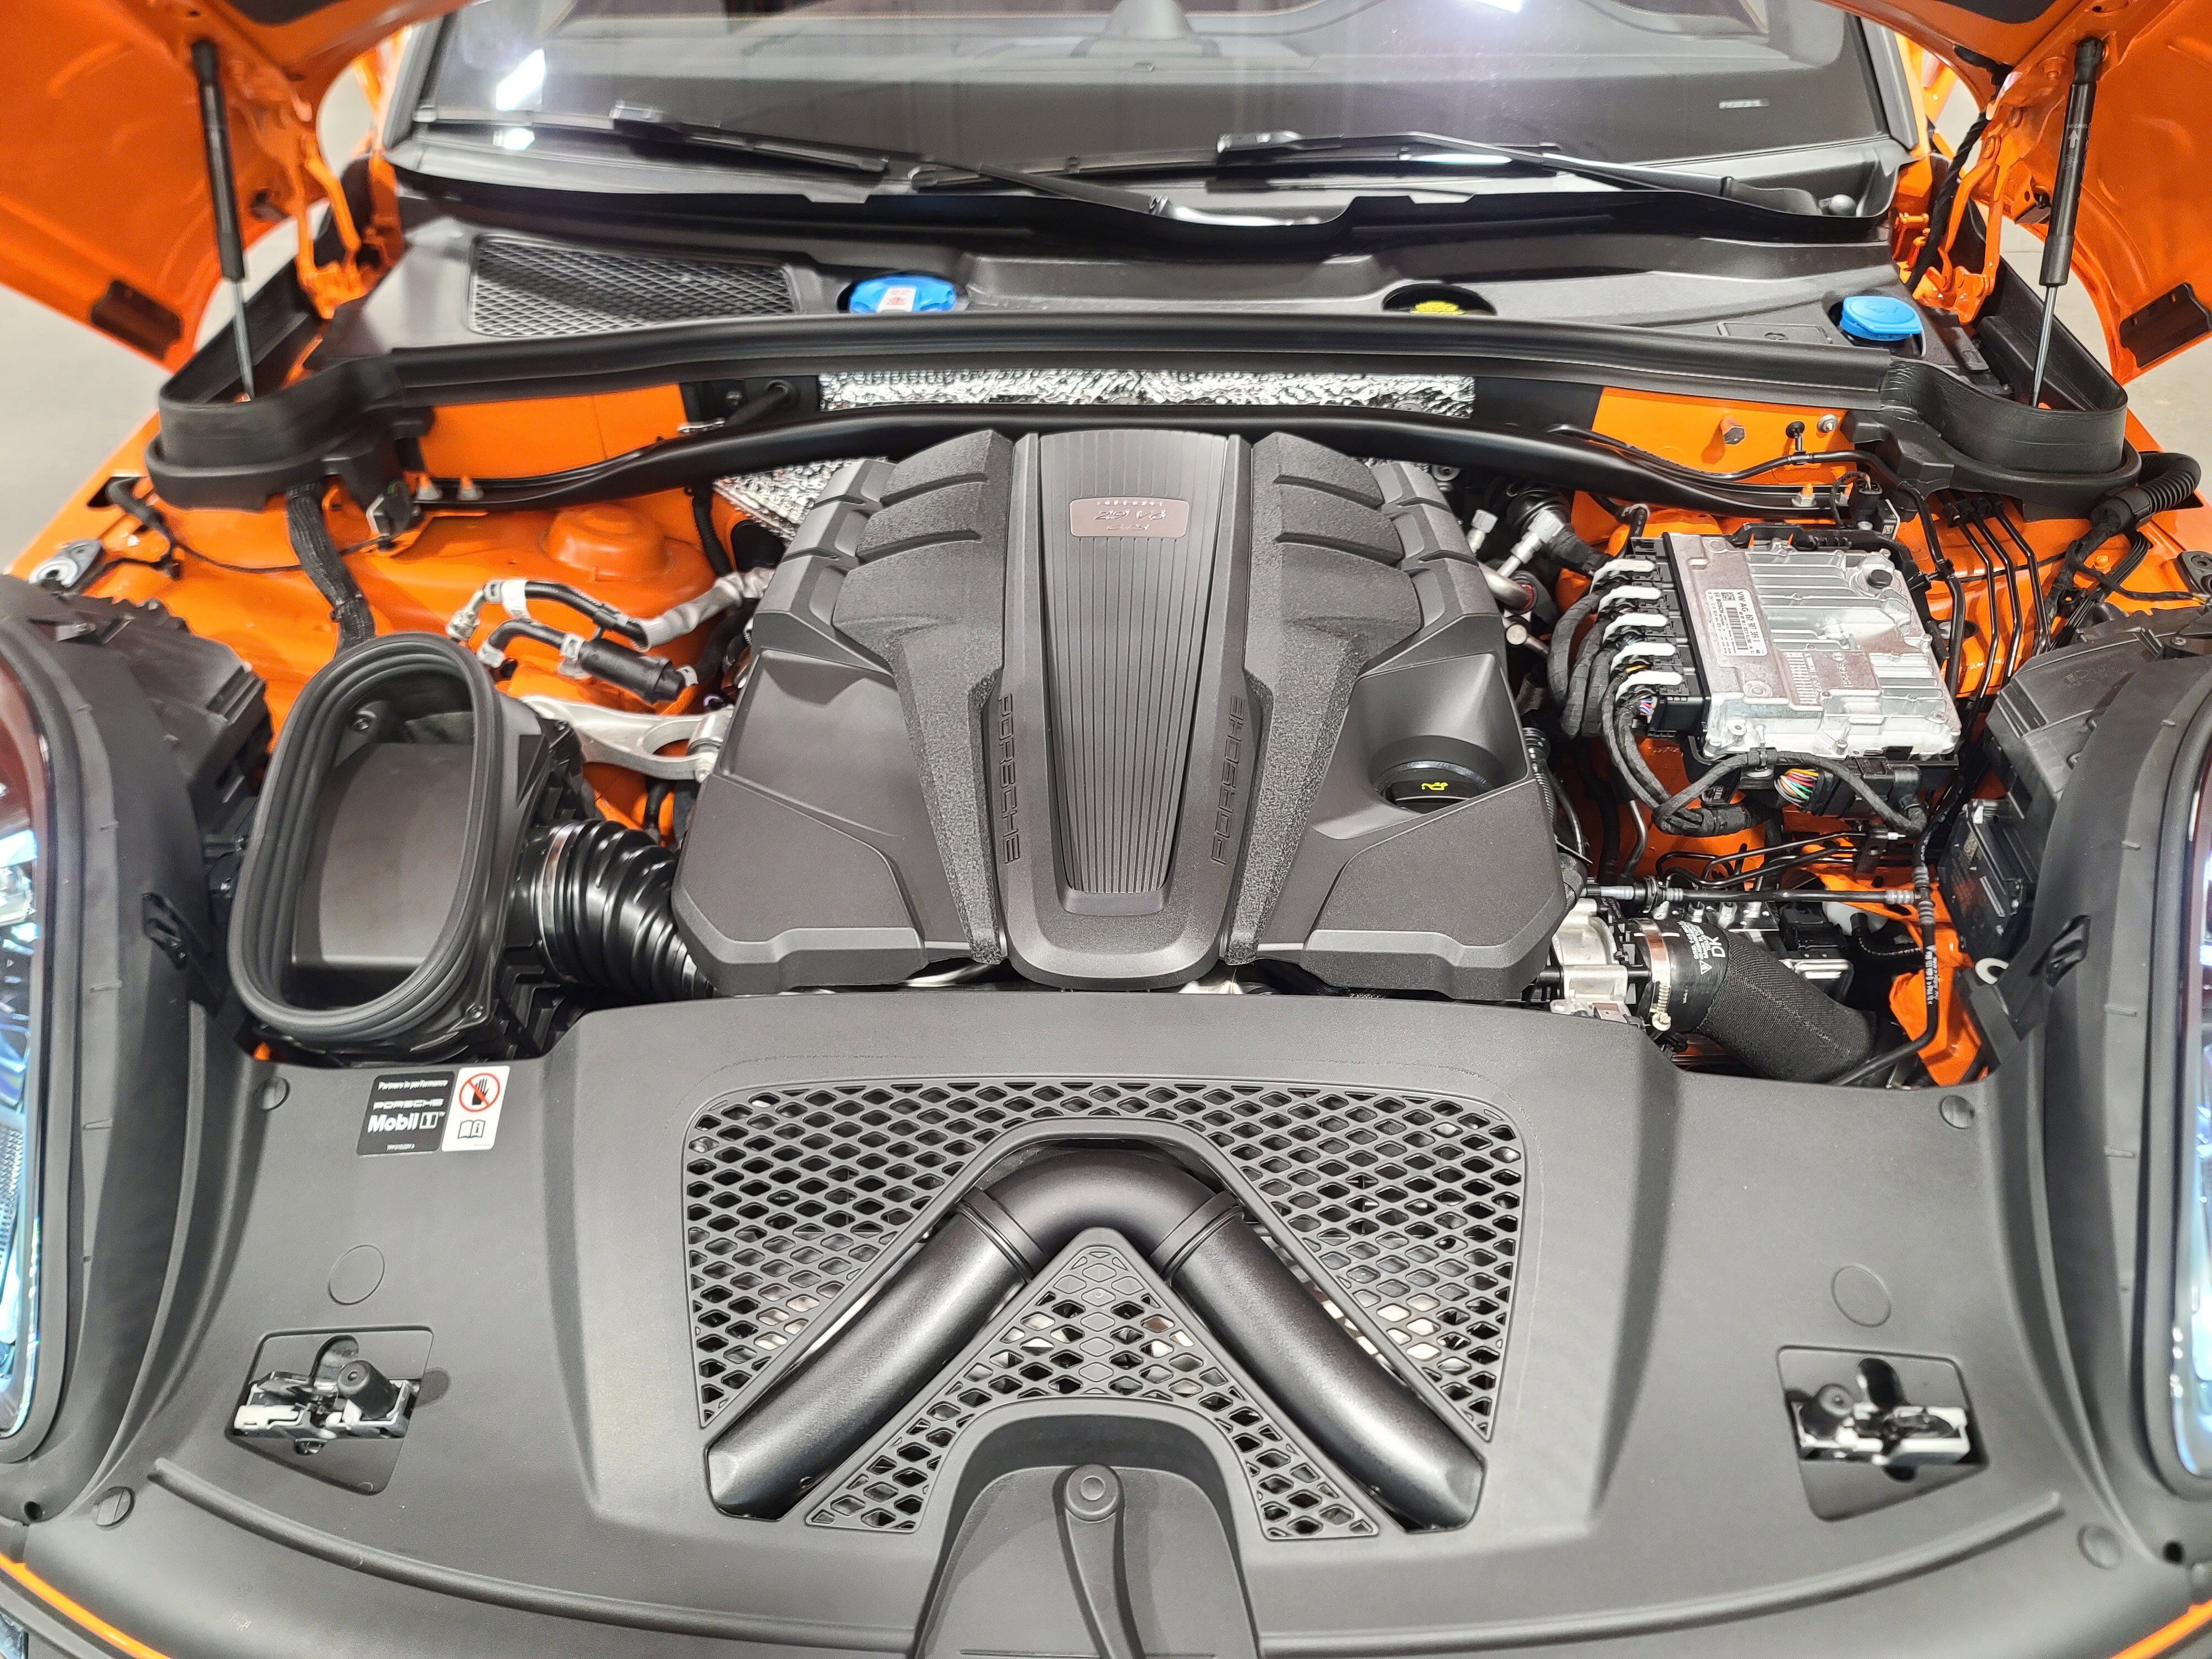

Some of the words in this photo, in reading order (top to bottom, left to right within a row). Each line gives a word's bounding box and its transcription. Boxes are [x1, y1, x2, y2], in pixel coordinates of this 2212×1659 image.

[1093, 509, 1130, 520] 2.9
[1136, 509, 1166, 520] V6
[1737, 591, 1746, 602] VW
[1716, 599, 1724, 613] BOSCH
[1740, 603, 1749, 612] AG
[998, 693, 1020, 864] PORSCHE
[1211, 695, 1247, 865] PORSCHE
[1707, 936, 1726, 958] DK
[378, 1081, 404, 1091] Partners
[404, 1080, 411, 1089] in
[409, 1079, 449, 1090] performance
[373, 1098, 445, 1110] PORSCHE
[367, 1113, 420, 1133] Mobil
